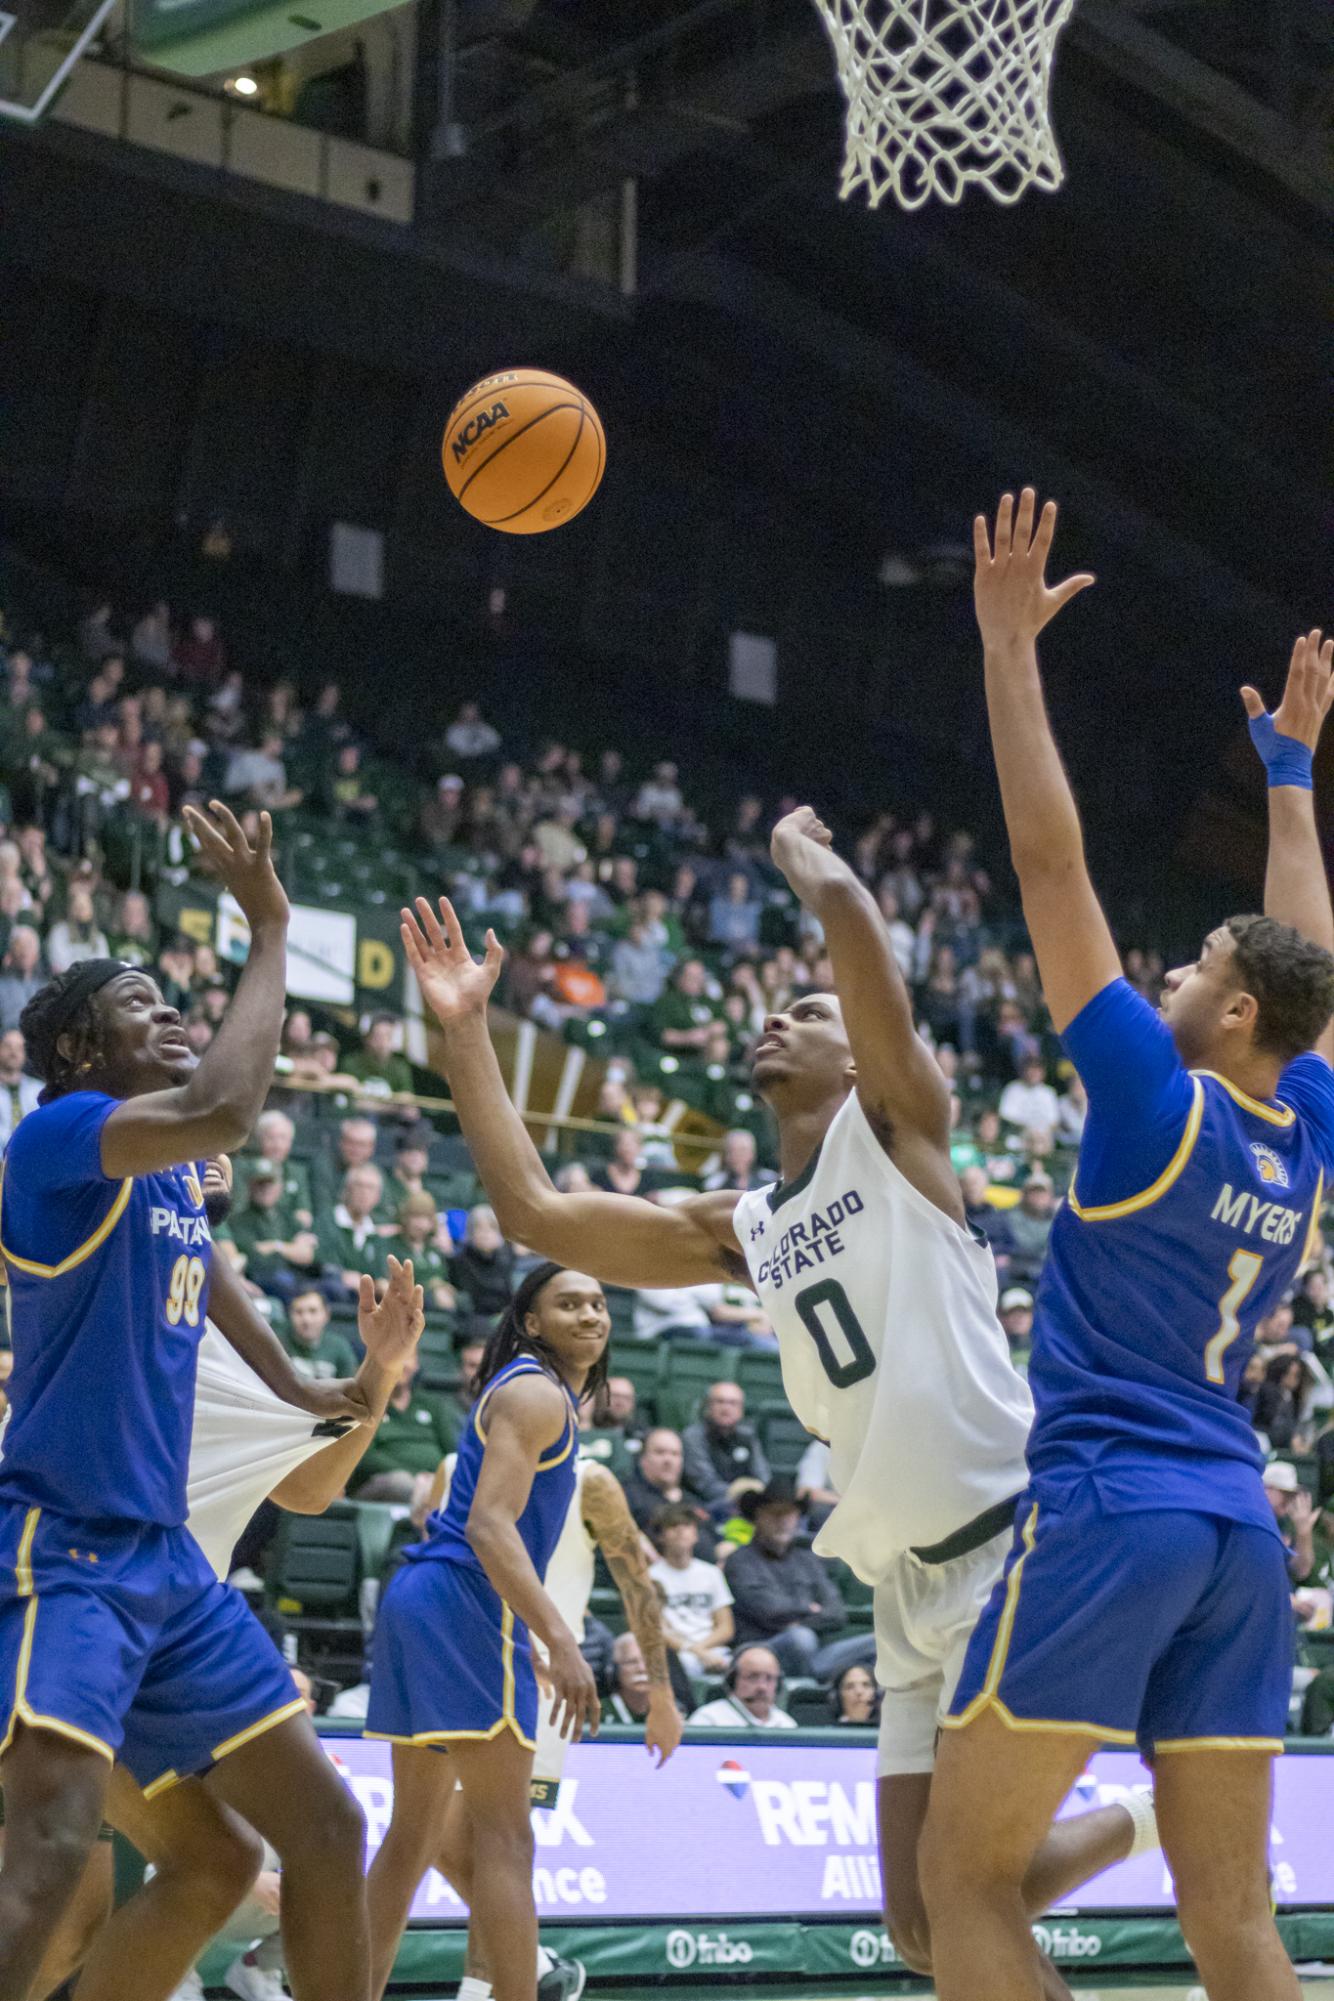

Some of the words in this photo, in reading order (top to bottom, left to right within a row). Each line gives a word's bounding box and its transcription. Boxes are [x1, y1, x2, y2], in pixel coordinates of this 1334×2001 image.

[452, 401, 511, 465] NCAA
[758, 1190, 865, 1283] CLORADO
[1210, 1183, 1303, 1245] MYERS
[166, 1254, 206, 1327] 99
[770, 1230, 846, 1290] STATE
[794, 1278, 877, 1389] 0
[1204, 1248, 1264, 1385] 1
[751, 1780, 880, 1846] REM
[821, 1854, 882, 1899] Alli
